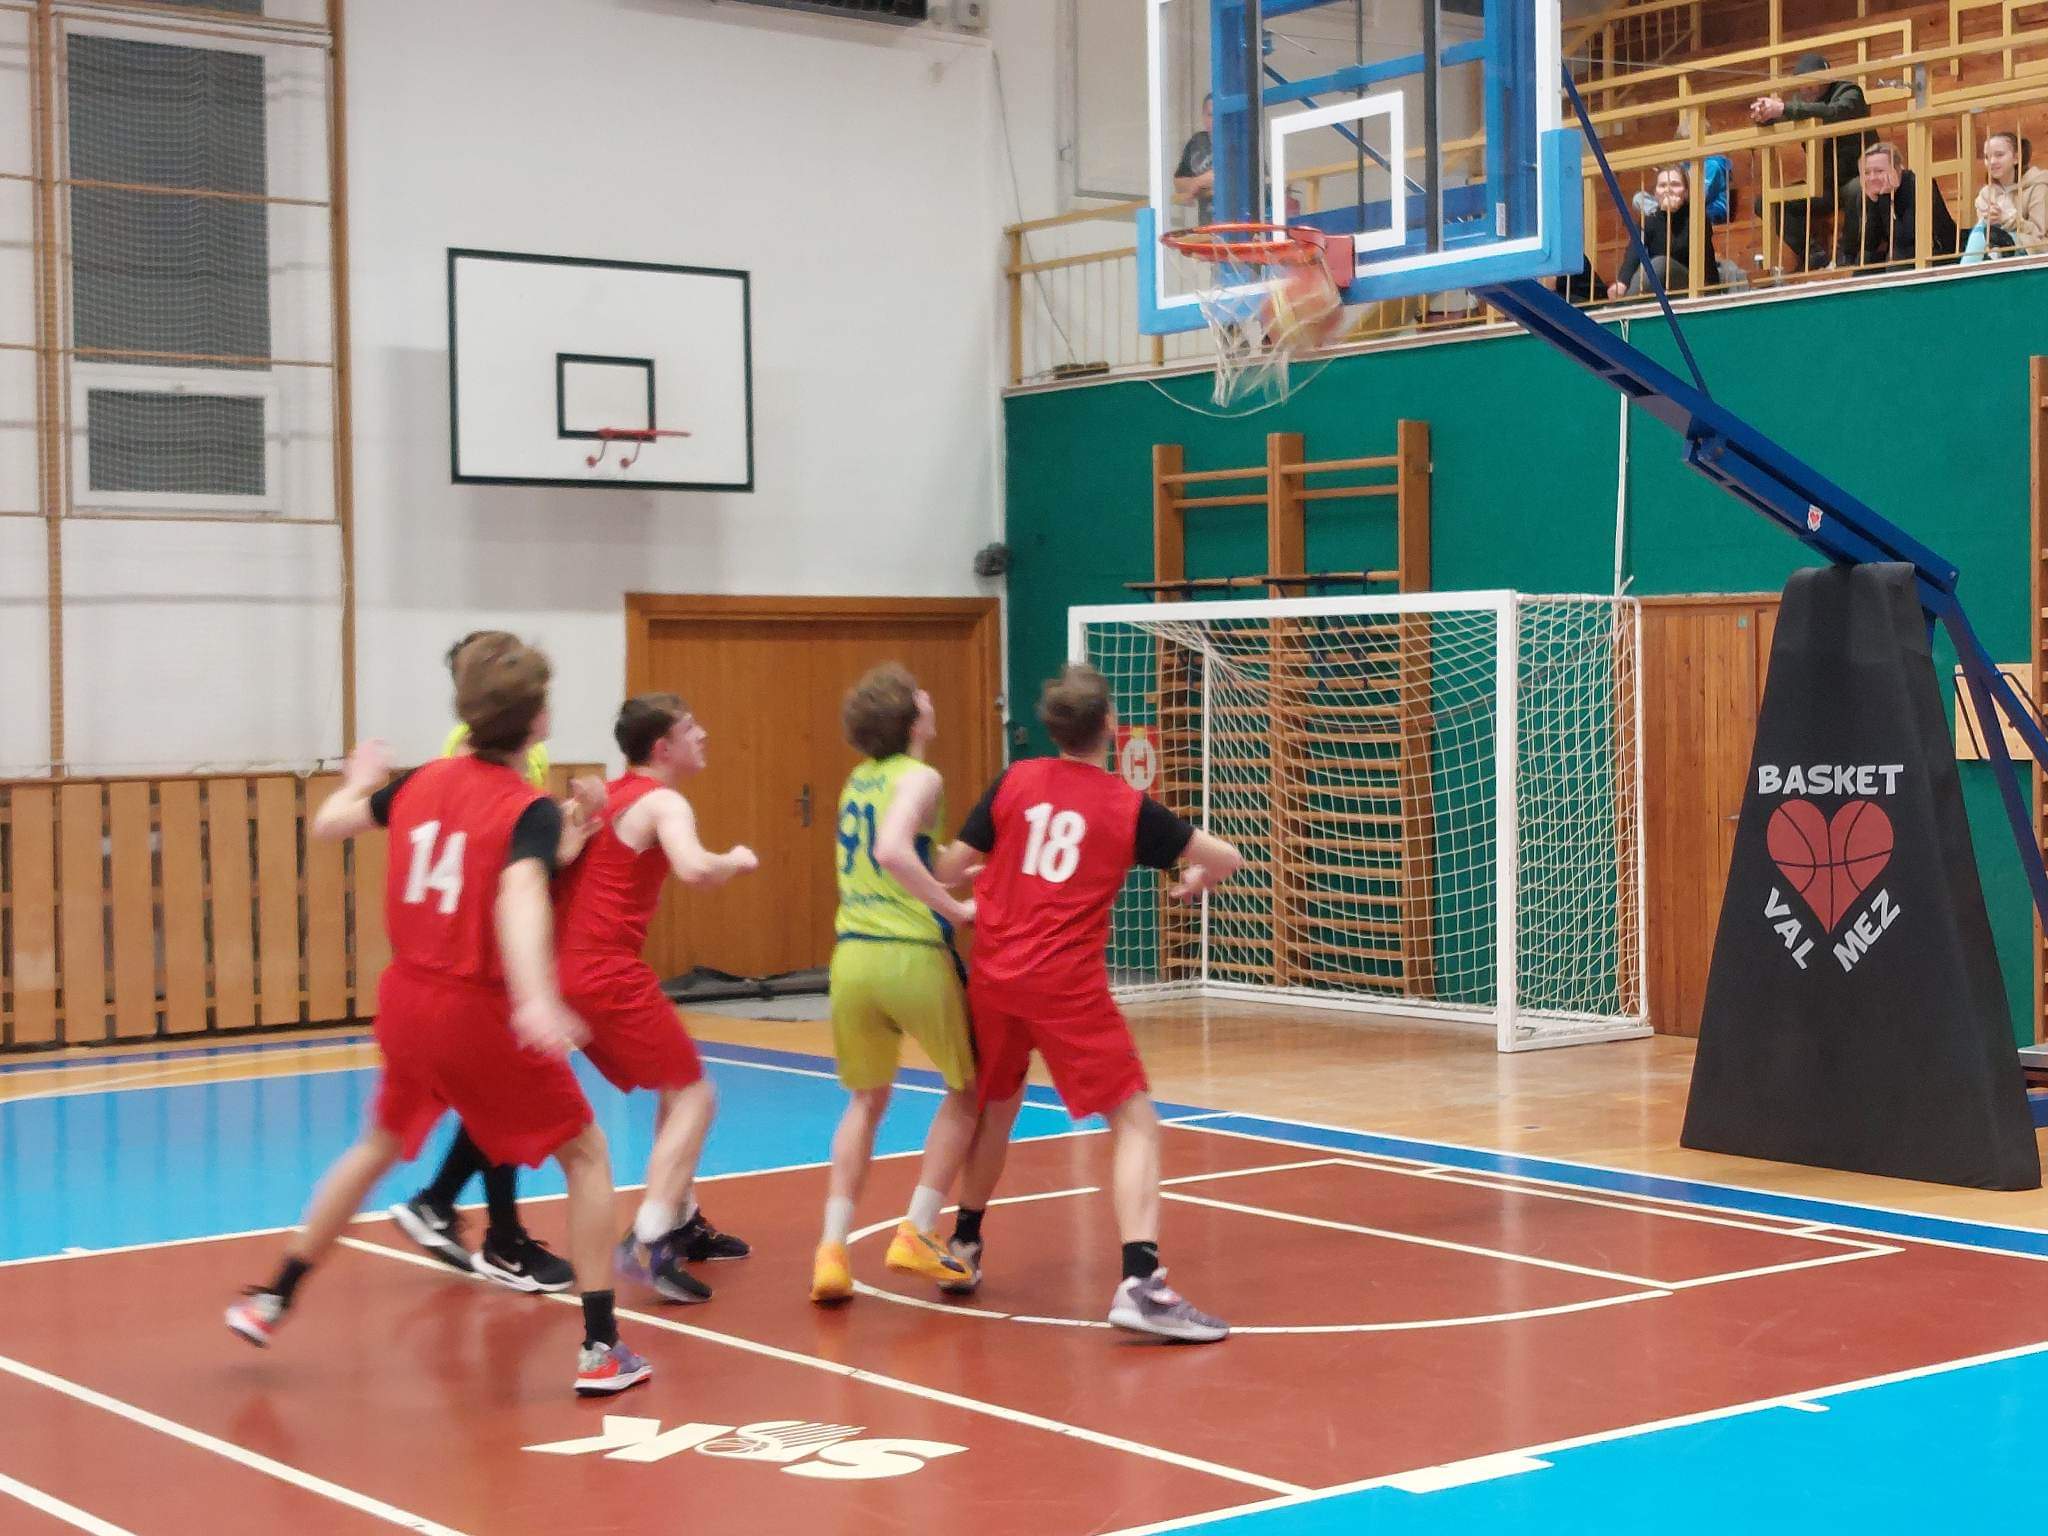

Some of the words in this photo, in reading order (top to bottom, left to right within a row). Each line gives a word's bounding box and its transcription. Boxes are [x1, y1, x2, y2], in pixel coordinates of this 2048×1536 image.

[1758, 764, 1904, 796] BASKET
[403, 819, 468, 915] 14
[838, 799, 883, 878] 91
[1021, 802, 1087, 884] 18
[1764, 887, 1815, 970] VAL
[1833, 888, 1901, 973] MEZ
